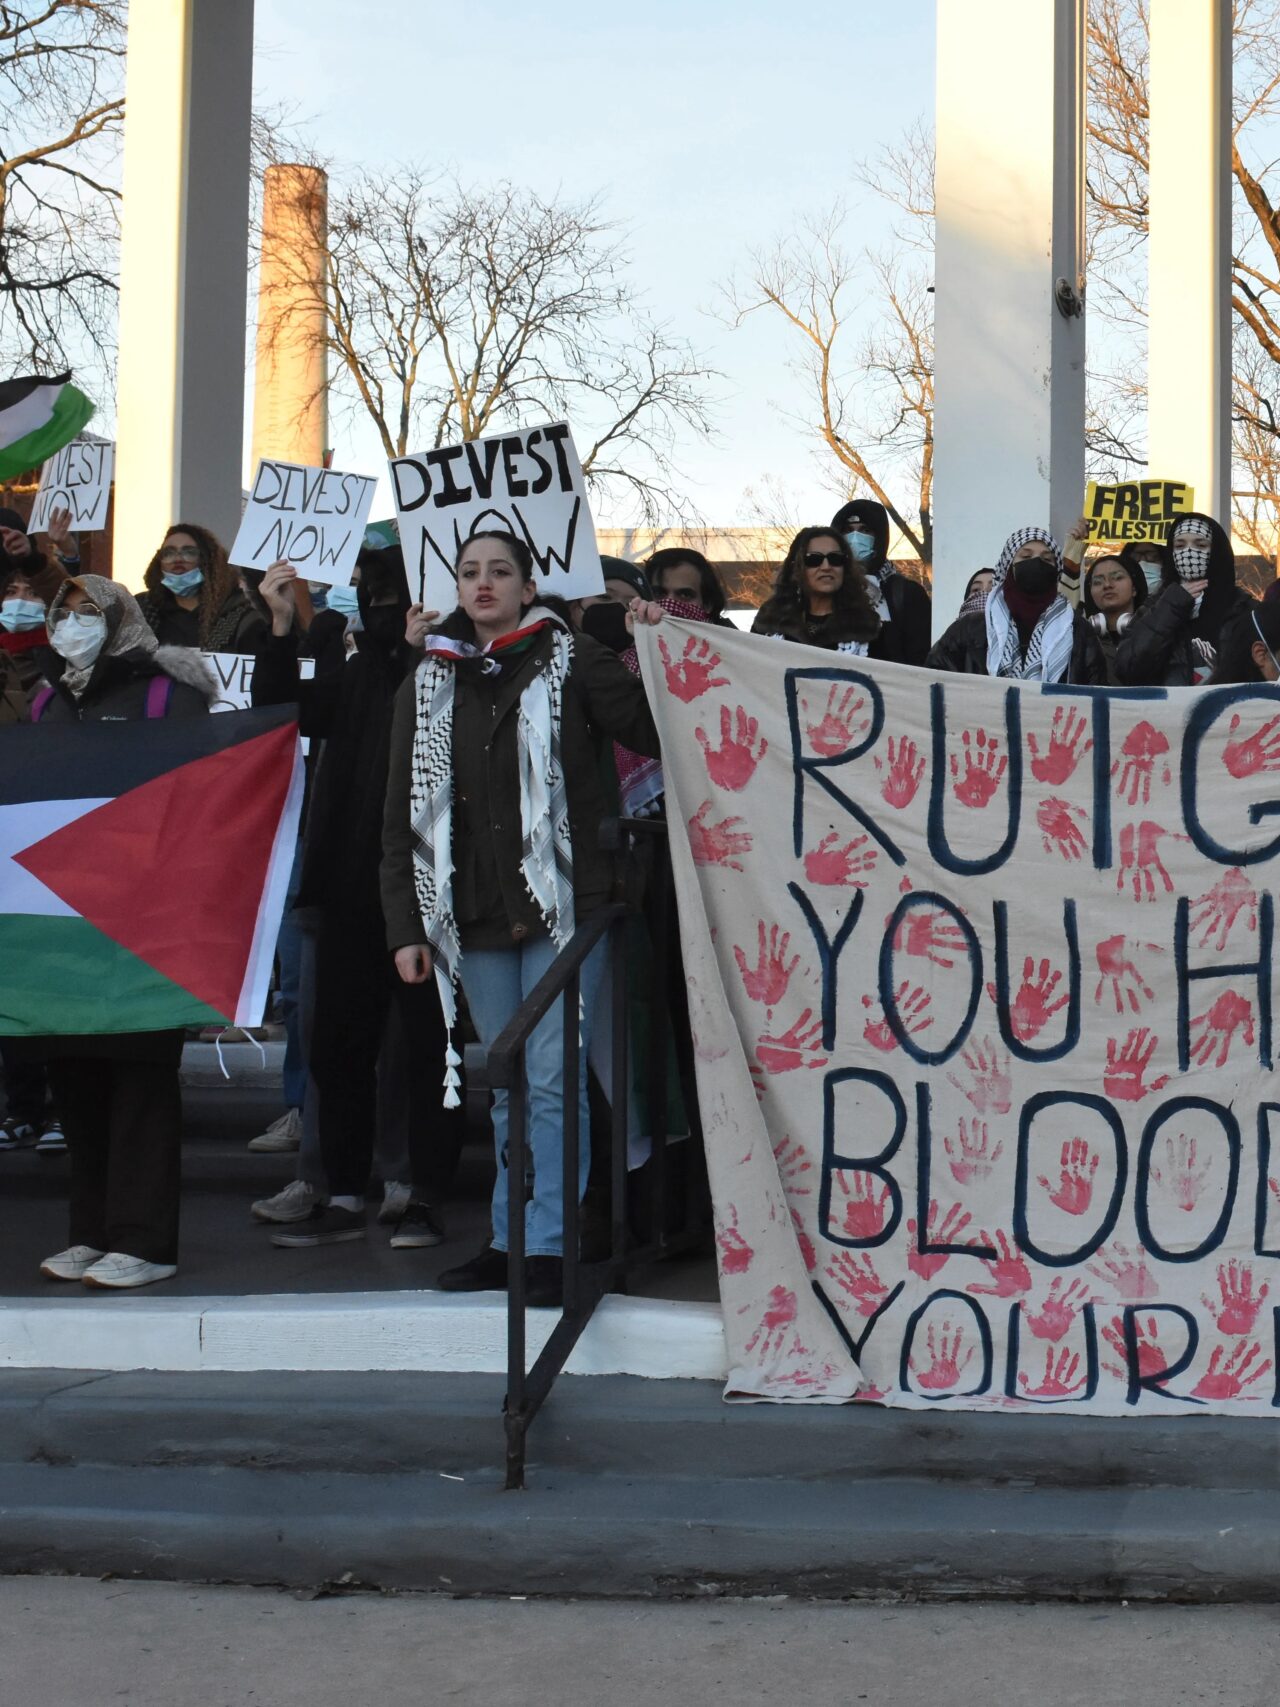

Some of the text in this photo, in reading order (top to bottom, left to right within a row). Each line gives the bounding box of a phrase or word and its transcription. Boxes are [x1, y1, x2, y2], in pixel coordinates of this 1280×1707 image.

[43, 442, 111, 491] IVEST
[252, 461, 375, 518] DIVEST
[392, 424, 573, 512] DIVEST
[1092, 482, 1186, 521] FREE
[252, 517, 352, 567] NOW
[787, 881, 1081, 1063] YOU
[811, 1279, 1209, 1406] YOUR
